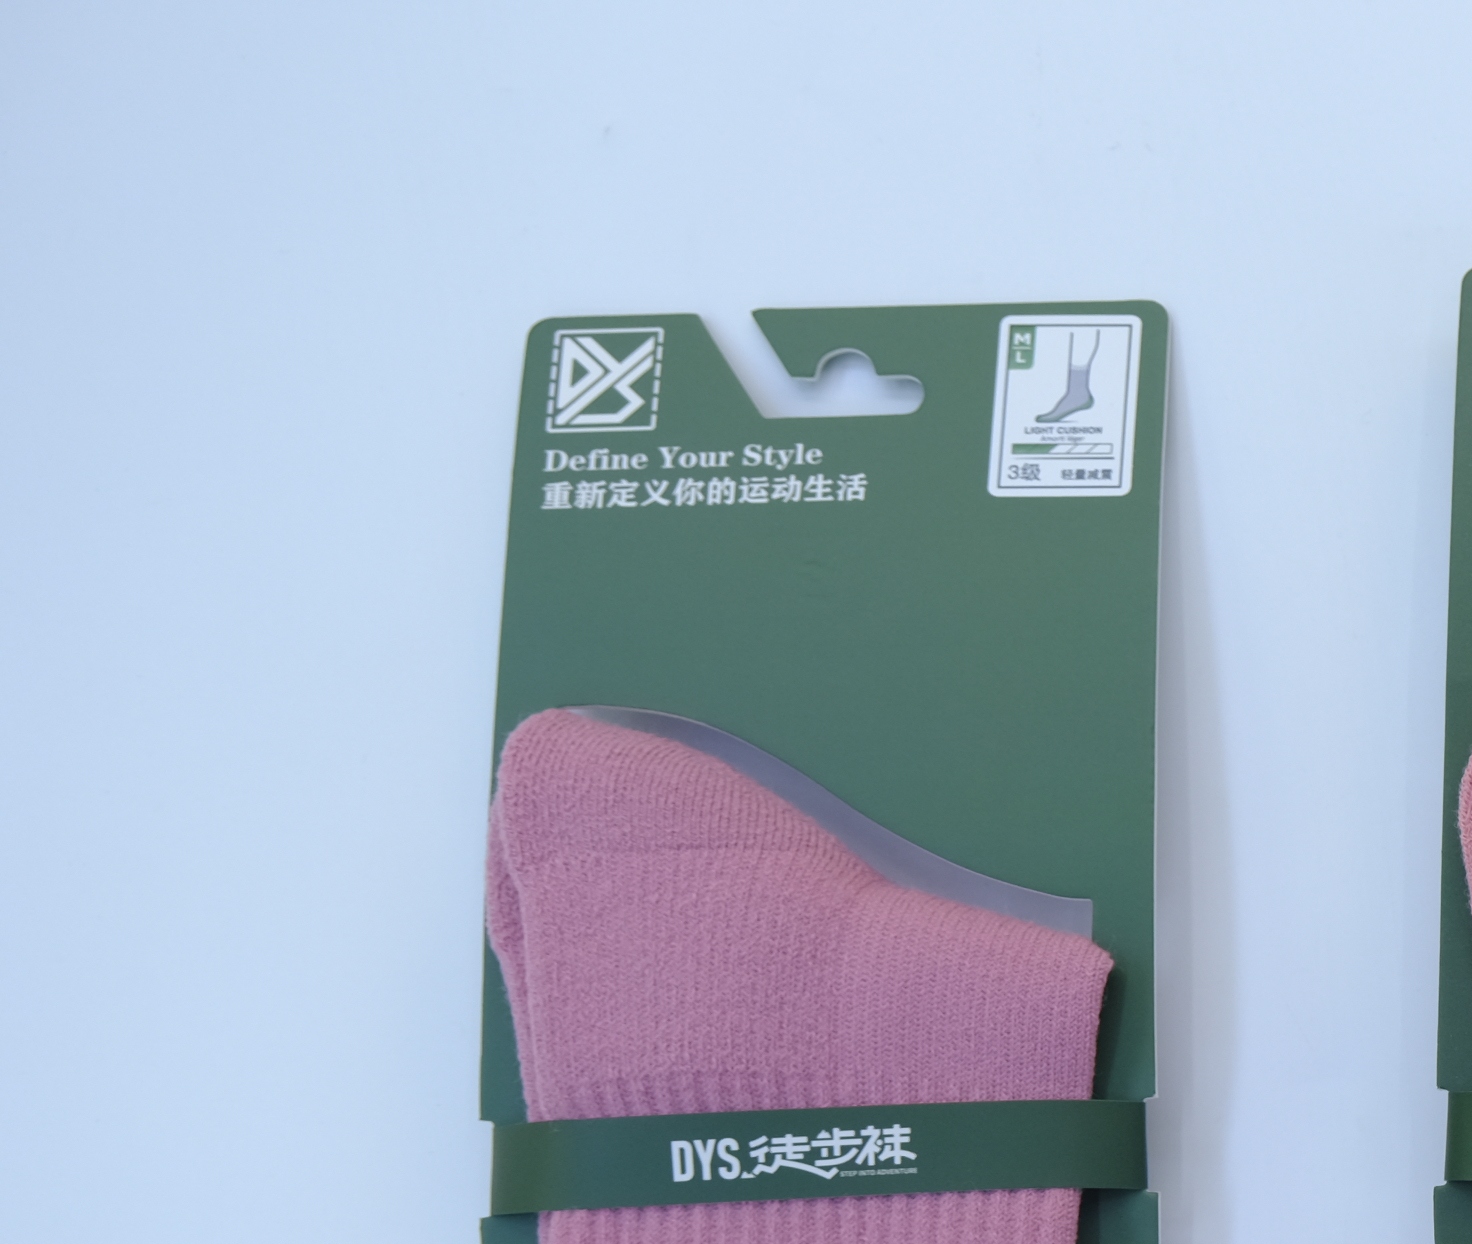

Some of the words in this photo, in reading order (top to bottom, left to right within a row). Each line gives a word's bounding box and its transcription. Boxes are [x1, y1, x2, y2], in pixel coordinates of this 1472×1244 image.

[1014, 333, 1031, 345] M
[1016, 351, 1026, 363] L
[543, 449, 648, 472] Define
[659, 447, 734, 469] Your
[742, 443, 823, 468] Style
[1008, 463, 1041, 481] 3级
[542, 474, 867, 510] 重新定义你的运动生活
[748, 1124, 917, 1180] 徒步袜
